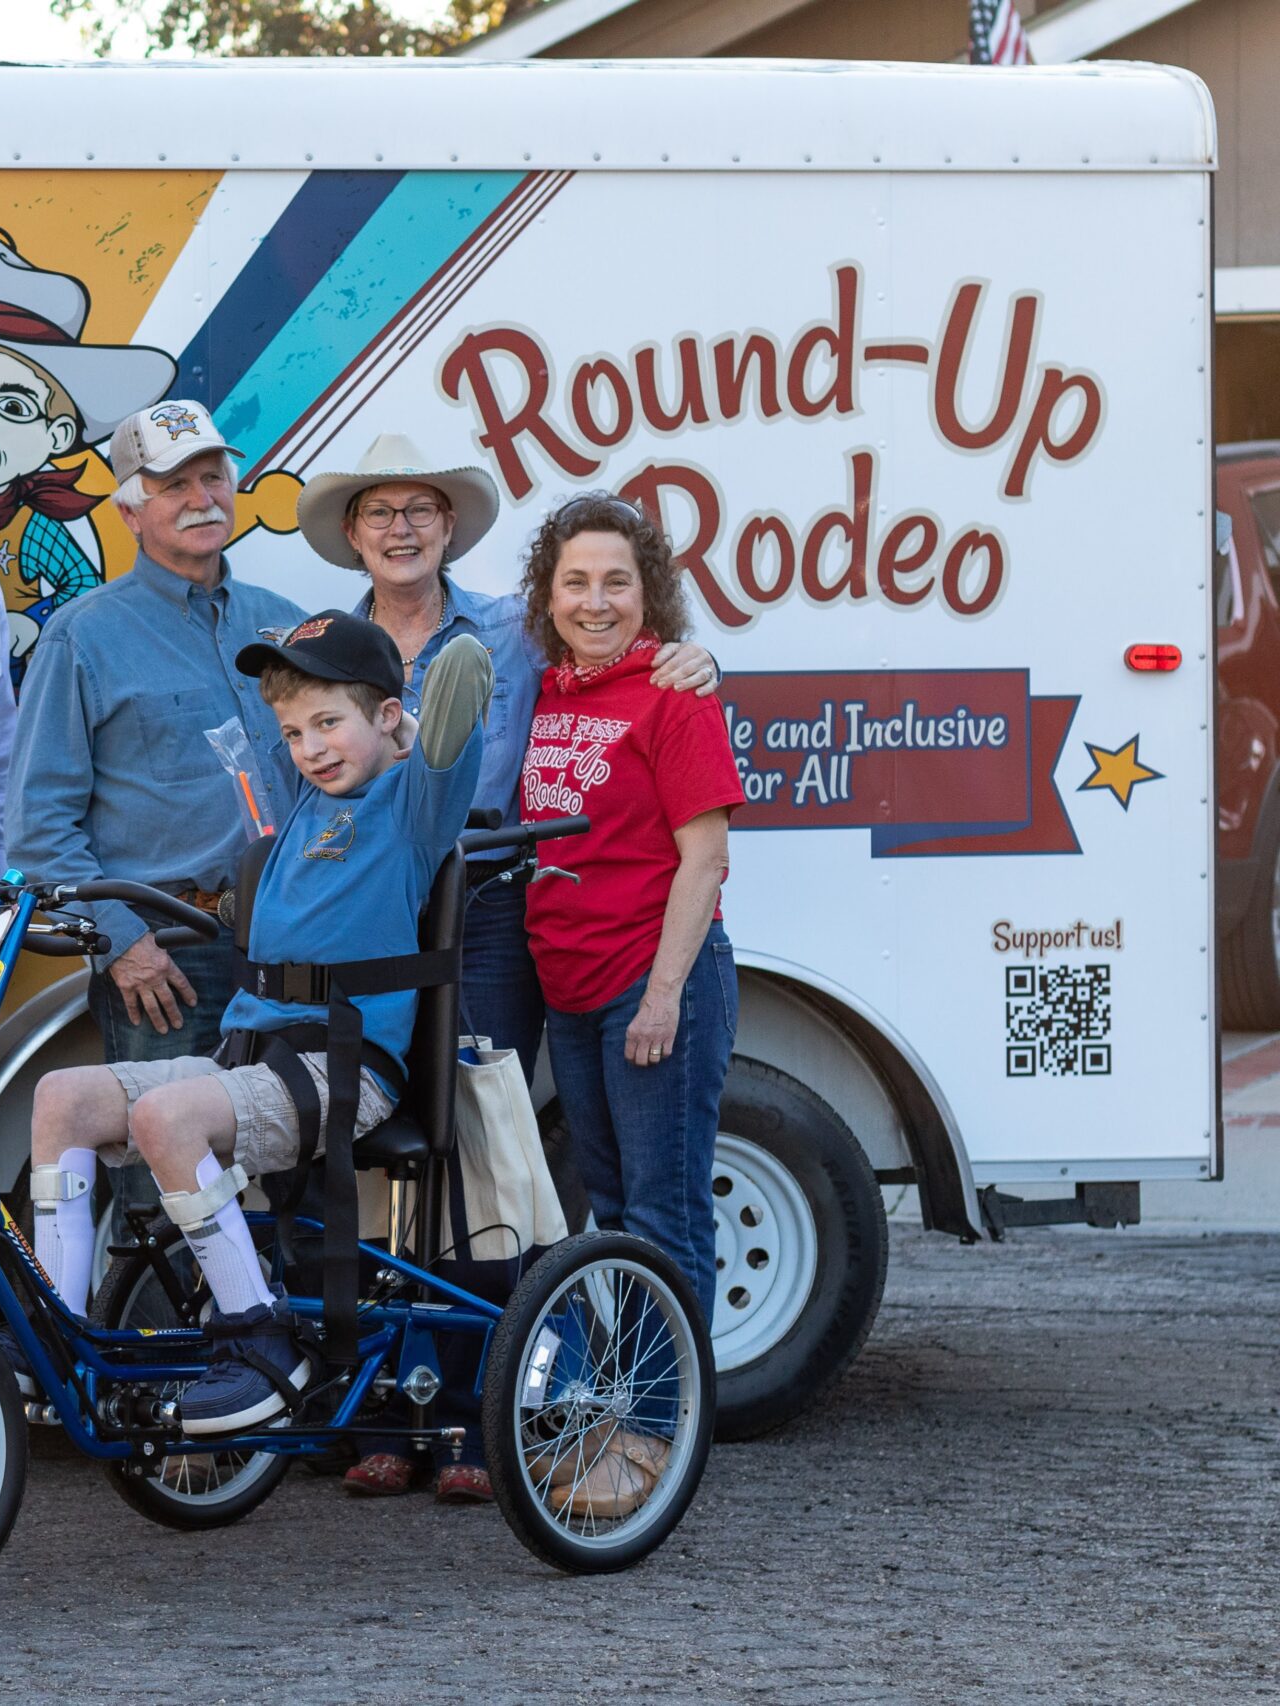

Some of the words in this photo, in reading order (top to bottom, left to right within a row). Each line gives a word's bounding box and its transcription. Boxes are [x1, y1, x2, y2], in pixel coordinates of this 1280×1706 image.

[440, 265, 1101, 499] Round-Up
[618, 452, 1004, 628] Rodeo
[766, 703, 832, 749] and
[845, 703, 1006, 752] Inclusive
[524, 769, 583, 815] Rodeo
[735, 757, 783, 801] for
[795, 754, 849, 804] All
[993, 921, 1089, 957] Support
[1091, 920, 1121, 949] us!
